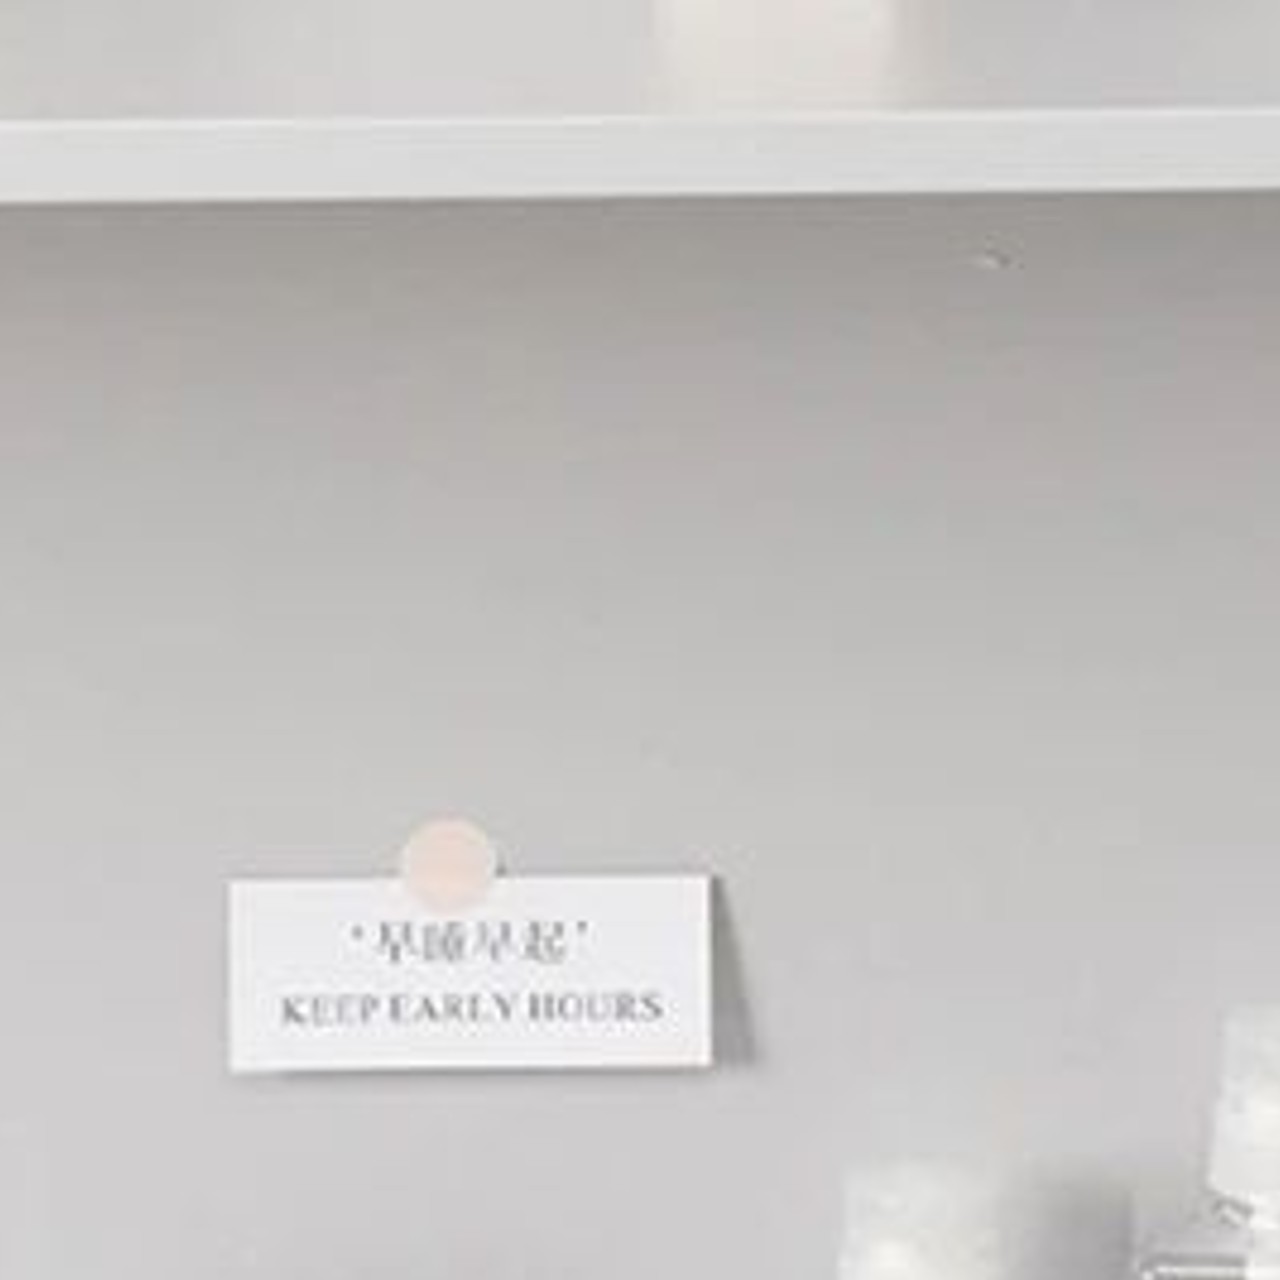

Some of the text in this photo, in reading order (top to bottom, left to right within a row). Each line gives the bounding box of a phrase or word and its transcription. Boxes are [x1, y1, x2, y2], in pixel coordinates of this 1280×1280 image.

[281, 991, 664, 1028] KEEP EARLY HOURS
